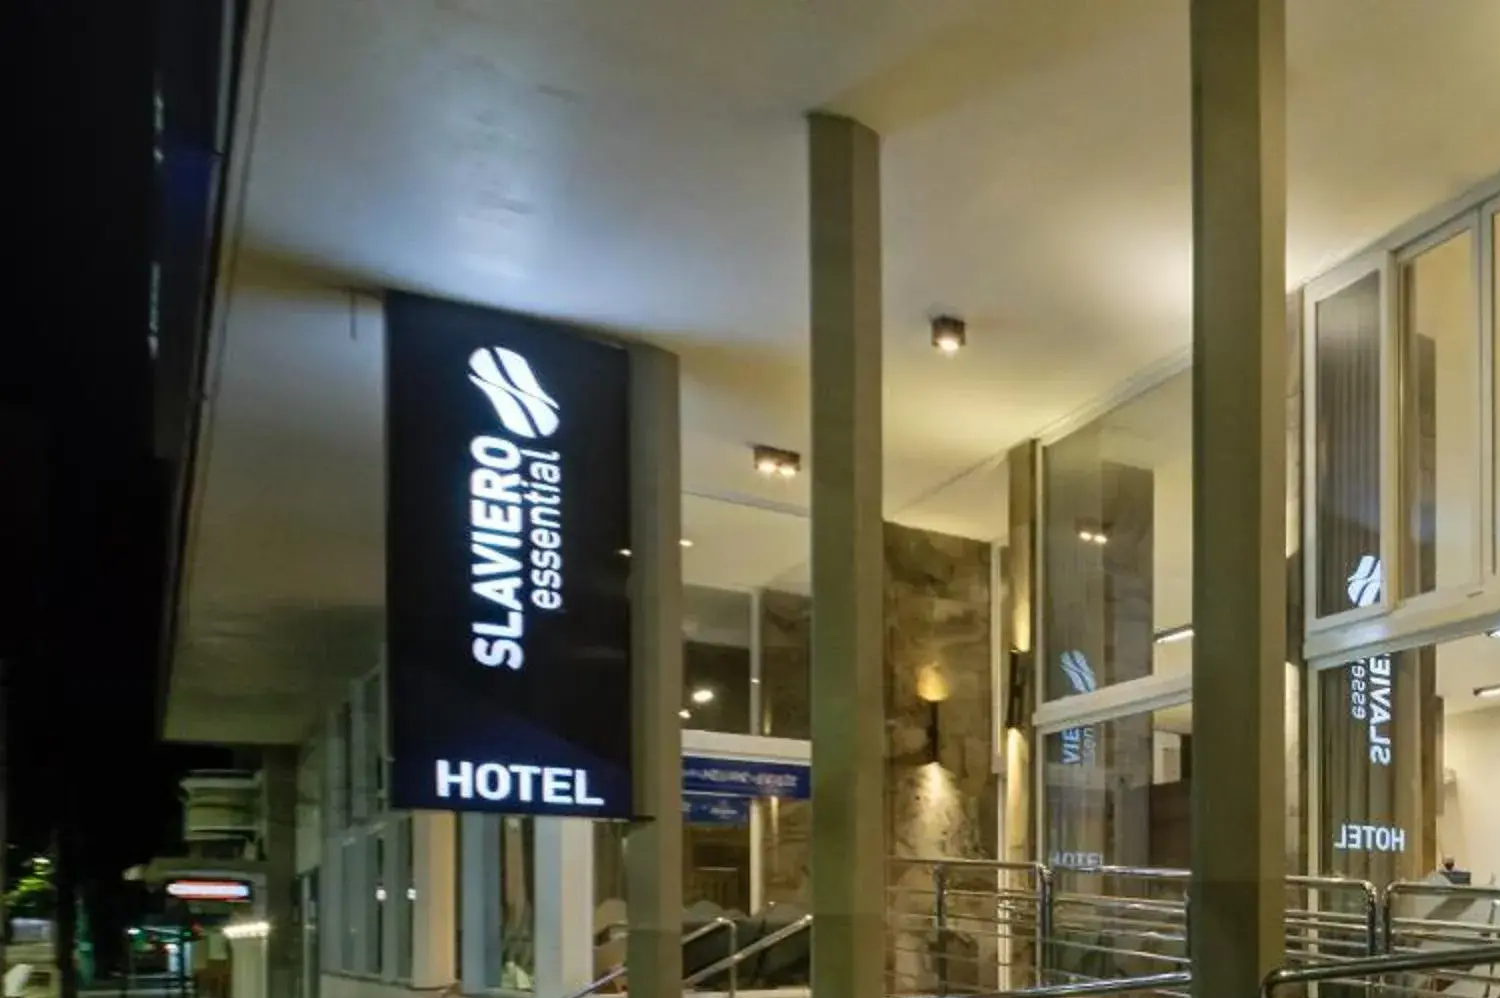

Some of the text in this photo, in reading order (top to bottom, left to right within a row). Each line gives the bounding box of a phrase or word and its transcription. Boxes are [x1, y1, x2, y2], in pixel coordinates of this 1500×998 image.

[470, 435, 525, 671] SLAVIERO
[519, 448, 563, 611] essential
[435, 758, 606, 807] HOTEL
